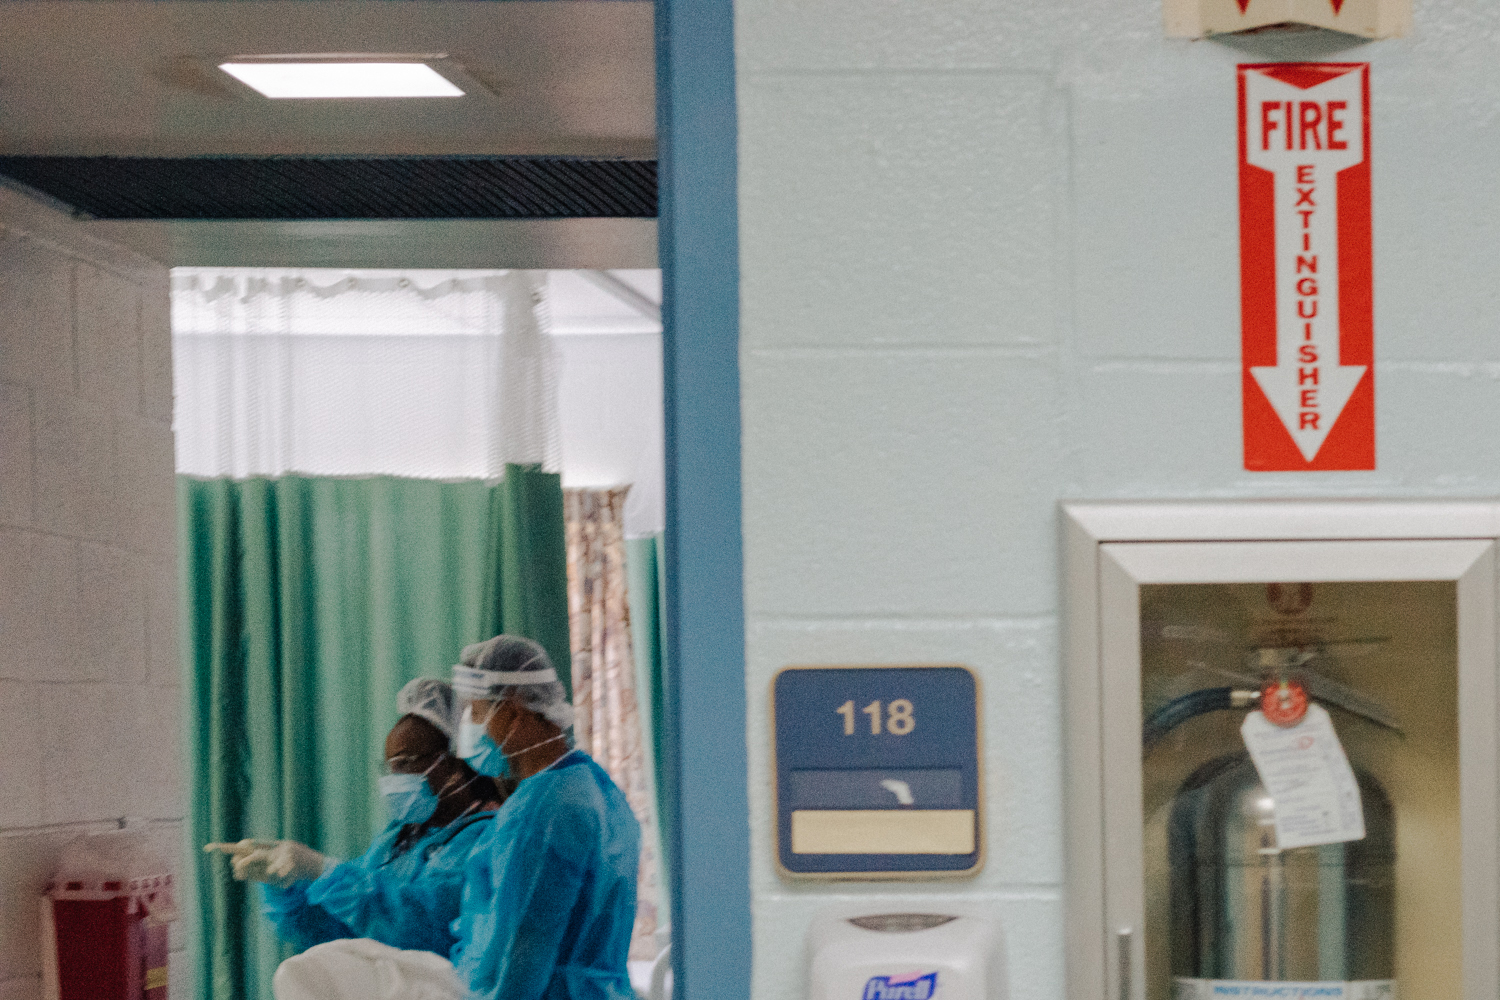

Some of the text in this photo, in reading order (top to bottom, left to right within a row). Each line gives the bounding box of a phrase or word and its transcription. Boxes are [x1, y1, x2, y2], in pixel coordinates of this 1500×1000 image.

[1261, 100, 1348, 150] FIRE
[1295, 164, 1320, 431] EXTINGUISHER
[836, 698, 916, 736] 118
